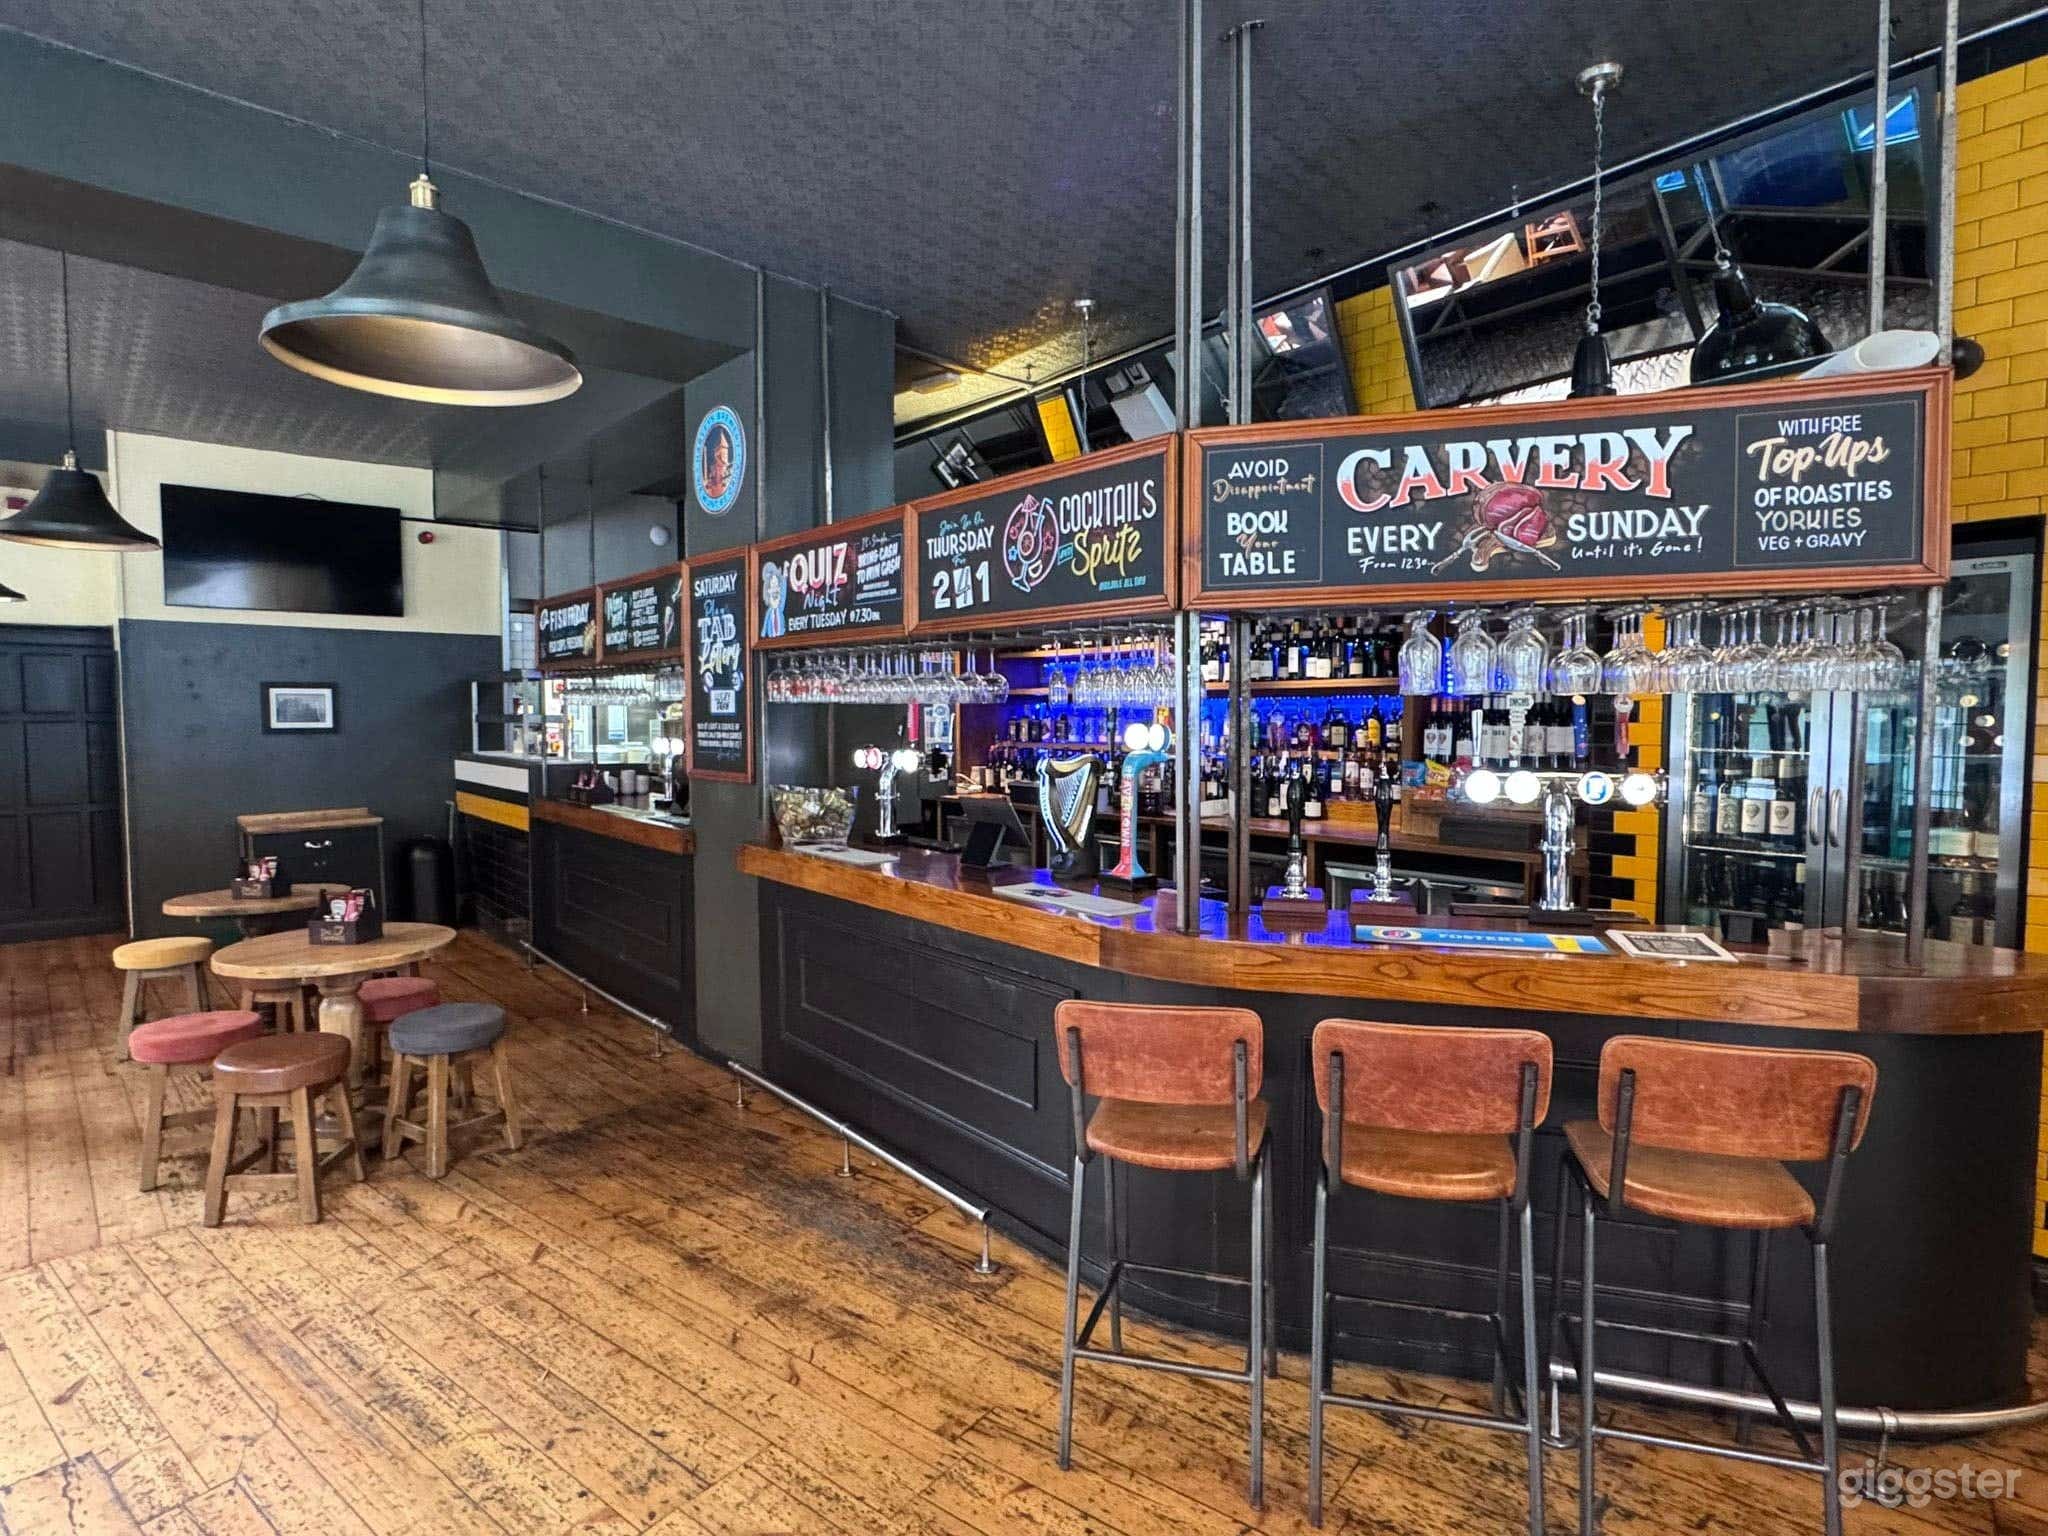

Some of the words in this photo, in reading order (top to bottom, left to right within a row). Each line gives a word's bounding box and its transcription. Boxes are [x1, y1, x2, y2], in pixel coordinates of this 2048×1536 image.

[1778, 418, 1819, 436] WITH
[1822, 415, 1862, 433] FREE
[1228, 458, 1289, 479] AVOID
[1336, 424, 1694, 513] CARVERY
[1060, 480, 1157, 534] COCKTAILS
[1754, 487, 1782, 508] OF
[1785, 480, 1892, 506] ROASTIES
[1227, 510, 1288, 535] BOOK
[1566, 504, 1710, 541] SUNDAY
[1755, 507, 1862, 532] YORKIES
[927, 525, 995, 560] THURSDAY
[1347, 521, 1443, 554] EVERY
[1572, 543, 1614, 559] Until
[1758, 536, 1790, 551] VEG
[1806, 530, 1867, 548] GRAVY
[790, 542, 848, 594] QUIZ
[1071, 523, 1142, 586] Spritz
[1219, 550, 1296, 576] TABLE
[695, 573, 737, 597] SATURDAY
